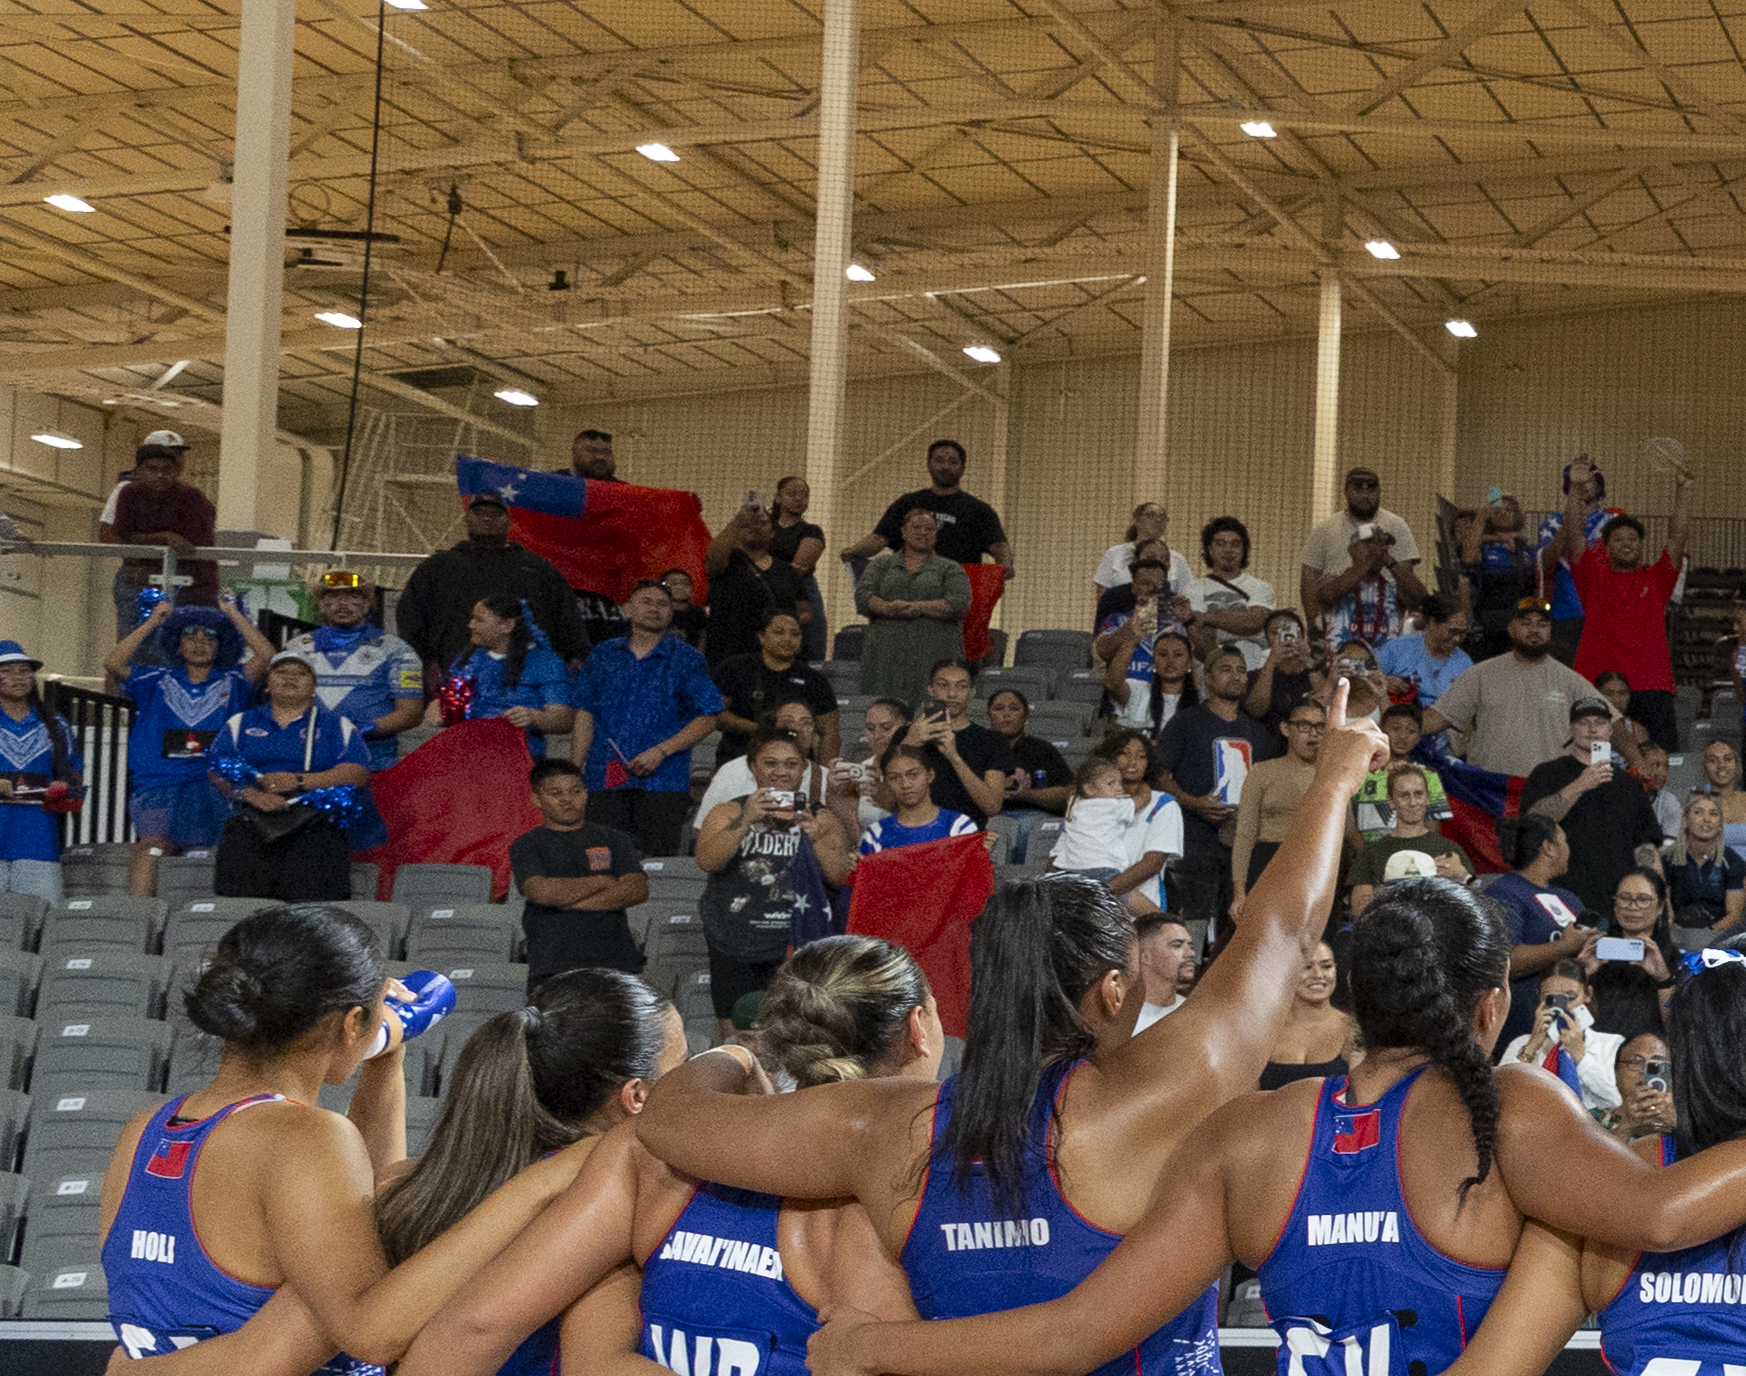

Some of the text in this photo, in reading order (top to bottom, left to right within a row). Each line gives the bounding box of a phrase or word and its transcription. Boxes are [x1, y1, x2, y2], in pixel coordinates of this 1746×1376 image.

[940, 1217, 1050, 1251] TANIMO
[1307, 1211, 1400, 1246] MANU'A
[131, 1230, 175, 1264] HOLI
